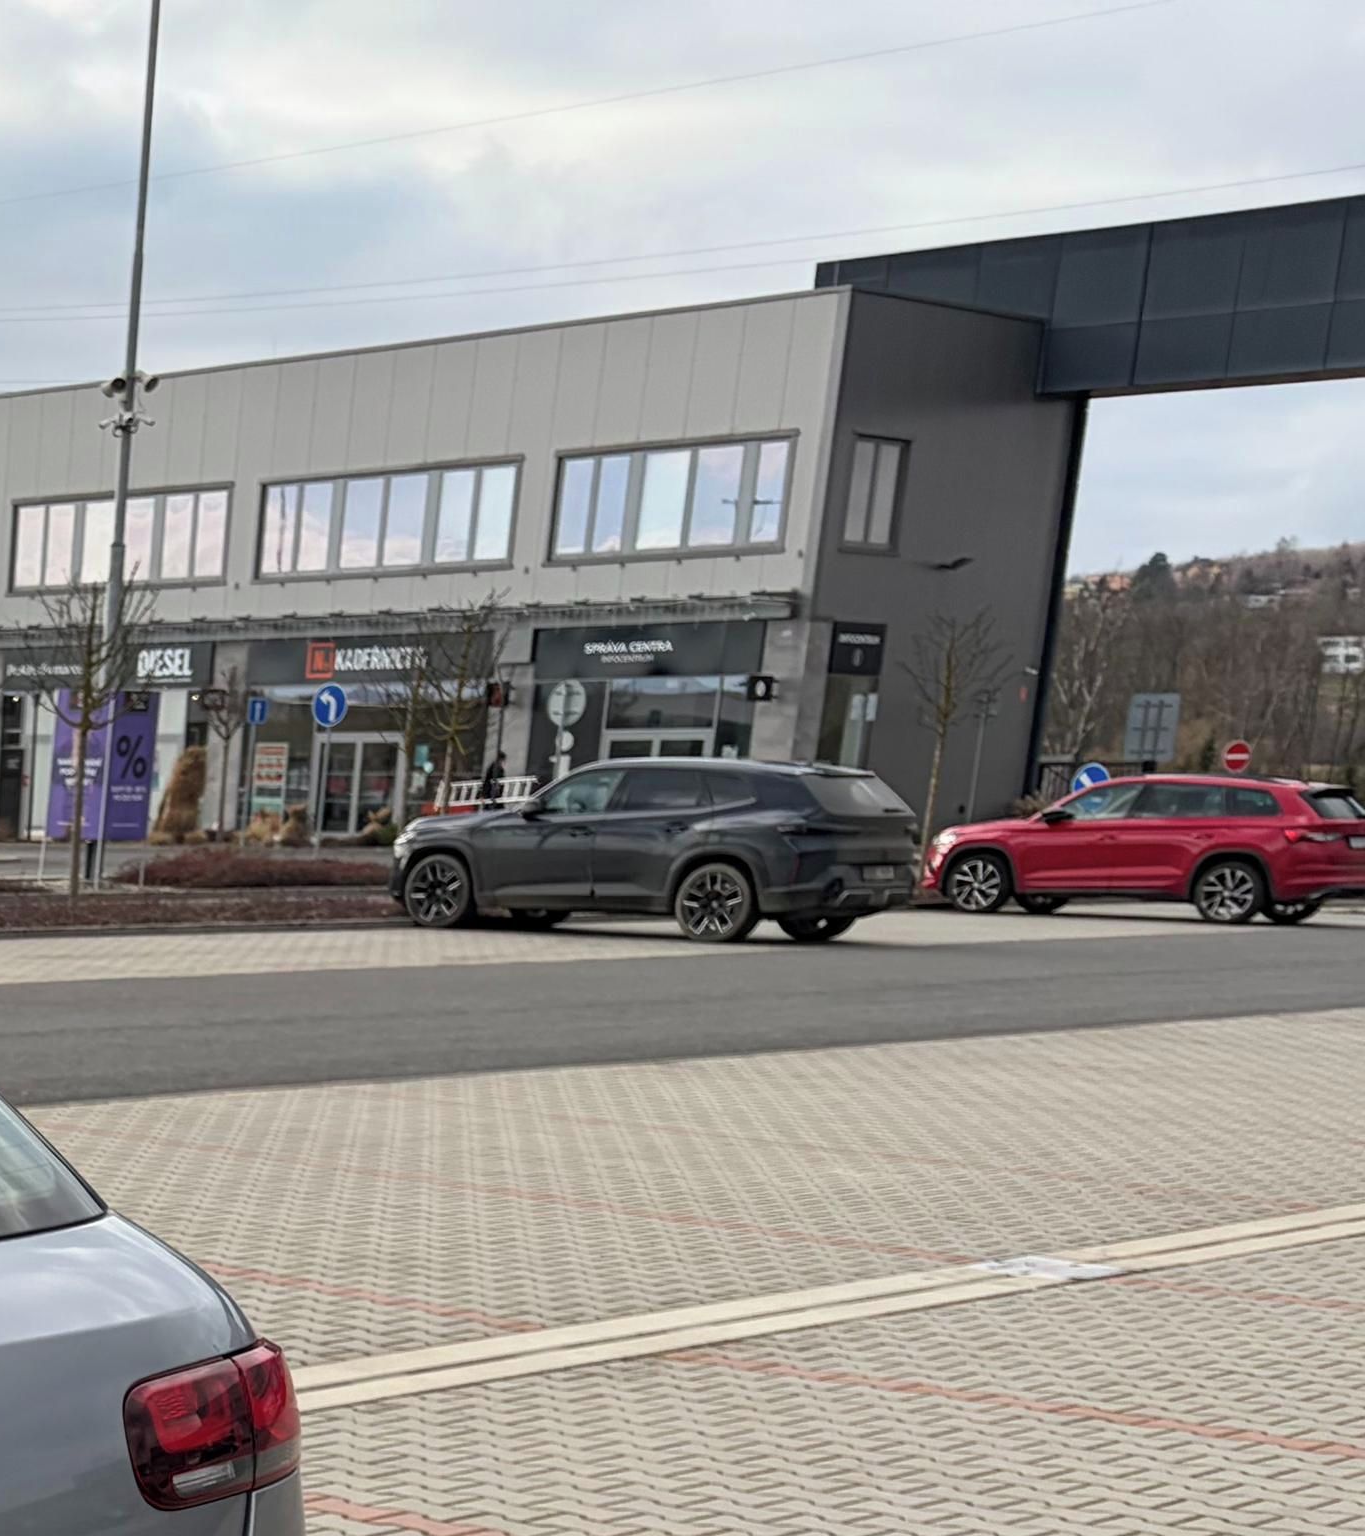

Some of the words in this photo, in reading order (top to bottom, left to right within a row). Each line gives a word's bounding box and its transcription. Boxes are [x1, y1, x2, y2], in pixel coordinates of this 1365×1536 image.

[584, 640, 628, 655] SPRÁVA
[629, 639, 674, 653] CENTRA
[136, 648, 194, 677] DIESEL
